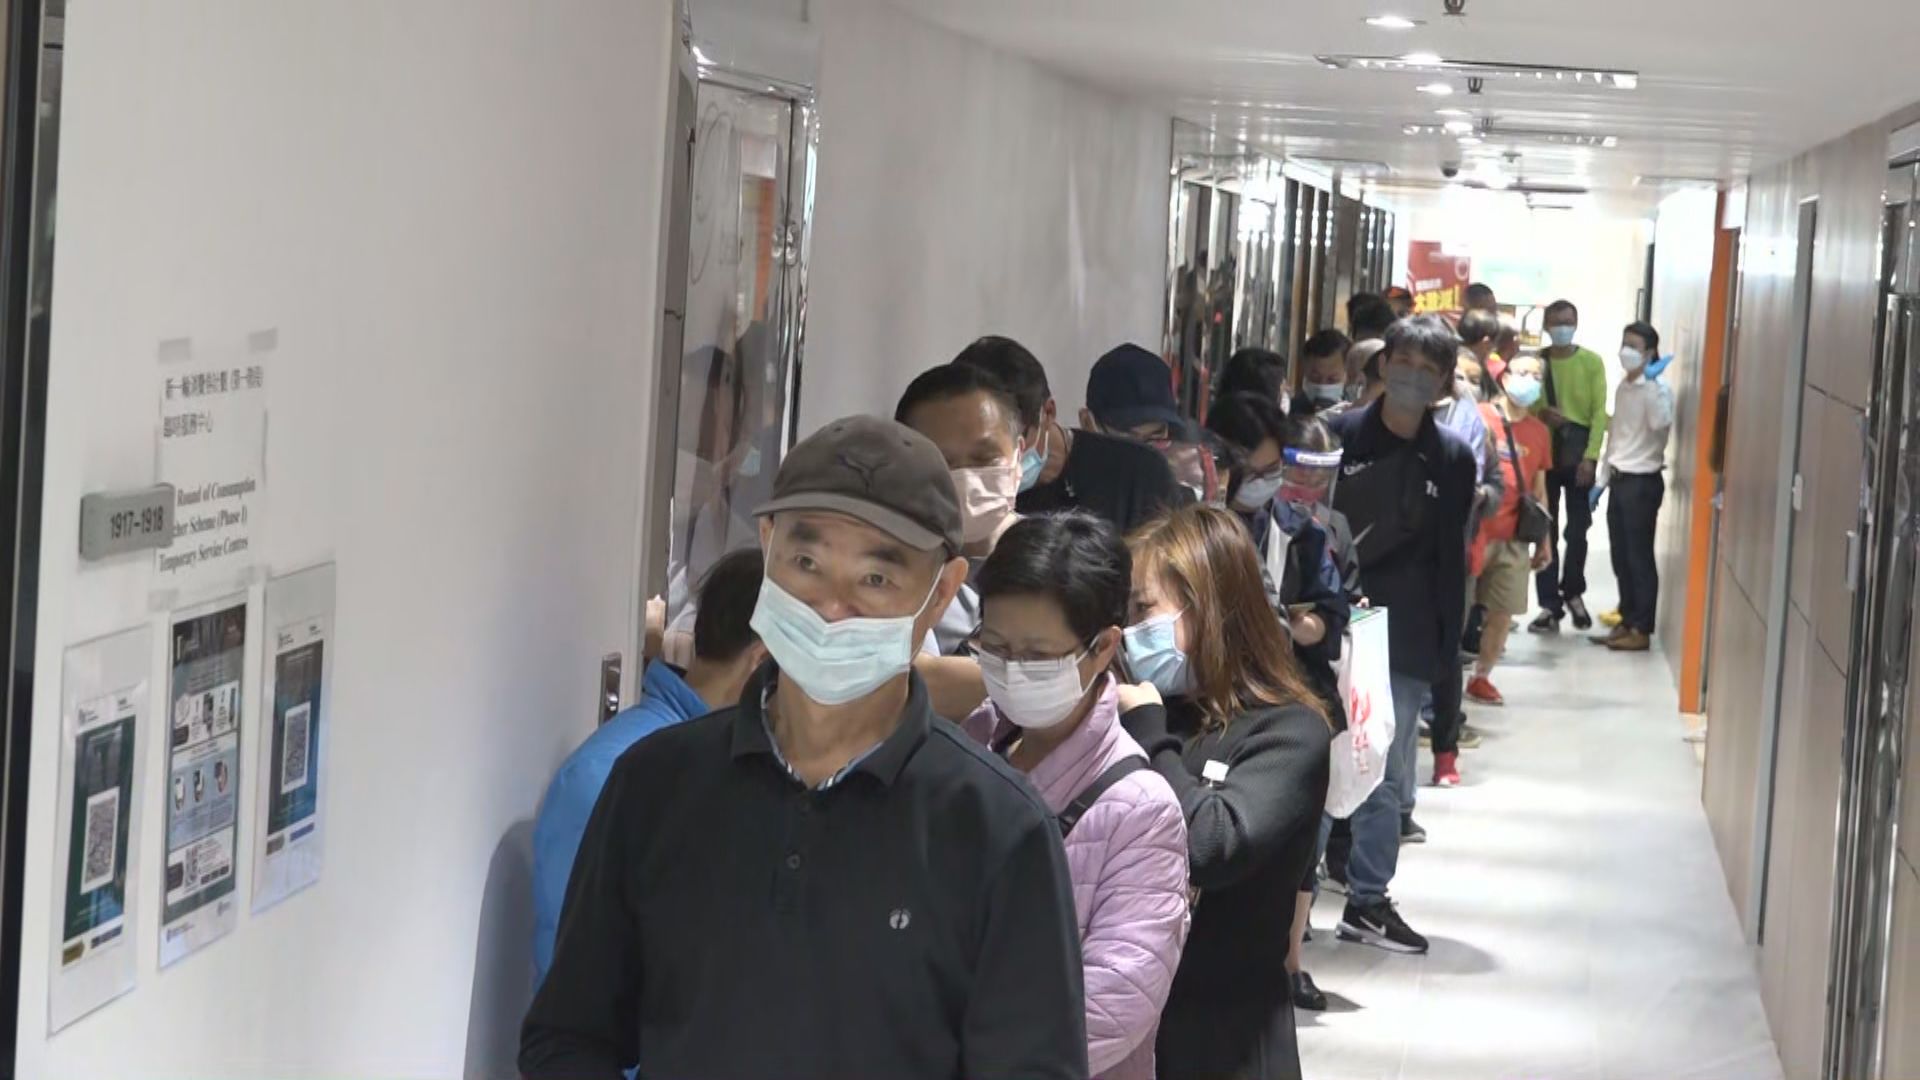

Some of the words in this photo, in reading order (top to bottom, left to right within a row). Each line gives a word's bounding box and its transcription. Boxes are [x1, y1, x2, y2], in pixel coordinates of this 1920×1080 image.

[177, 484, 201, 507] Round
[202, 482, 211, 502] of
[211, 477, 256, 500] Consumption
[111, 506, 164, 539] 1917-1918
[190, 512, 217, 532] Scheme
[217, 508, 241, 527] (Phase
[159, 549, 197, 575] Temporary
[198, 539, 223, 561] Service
